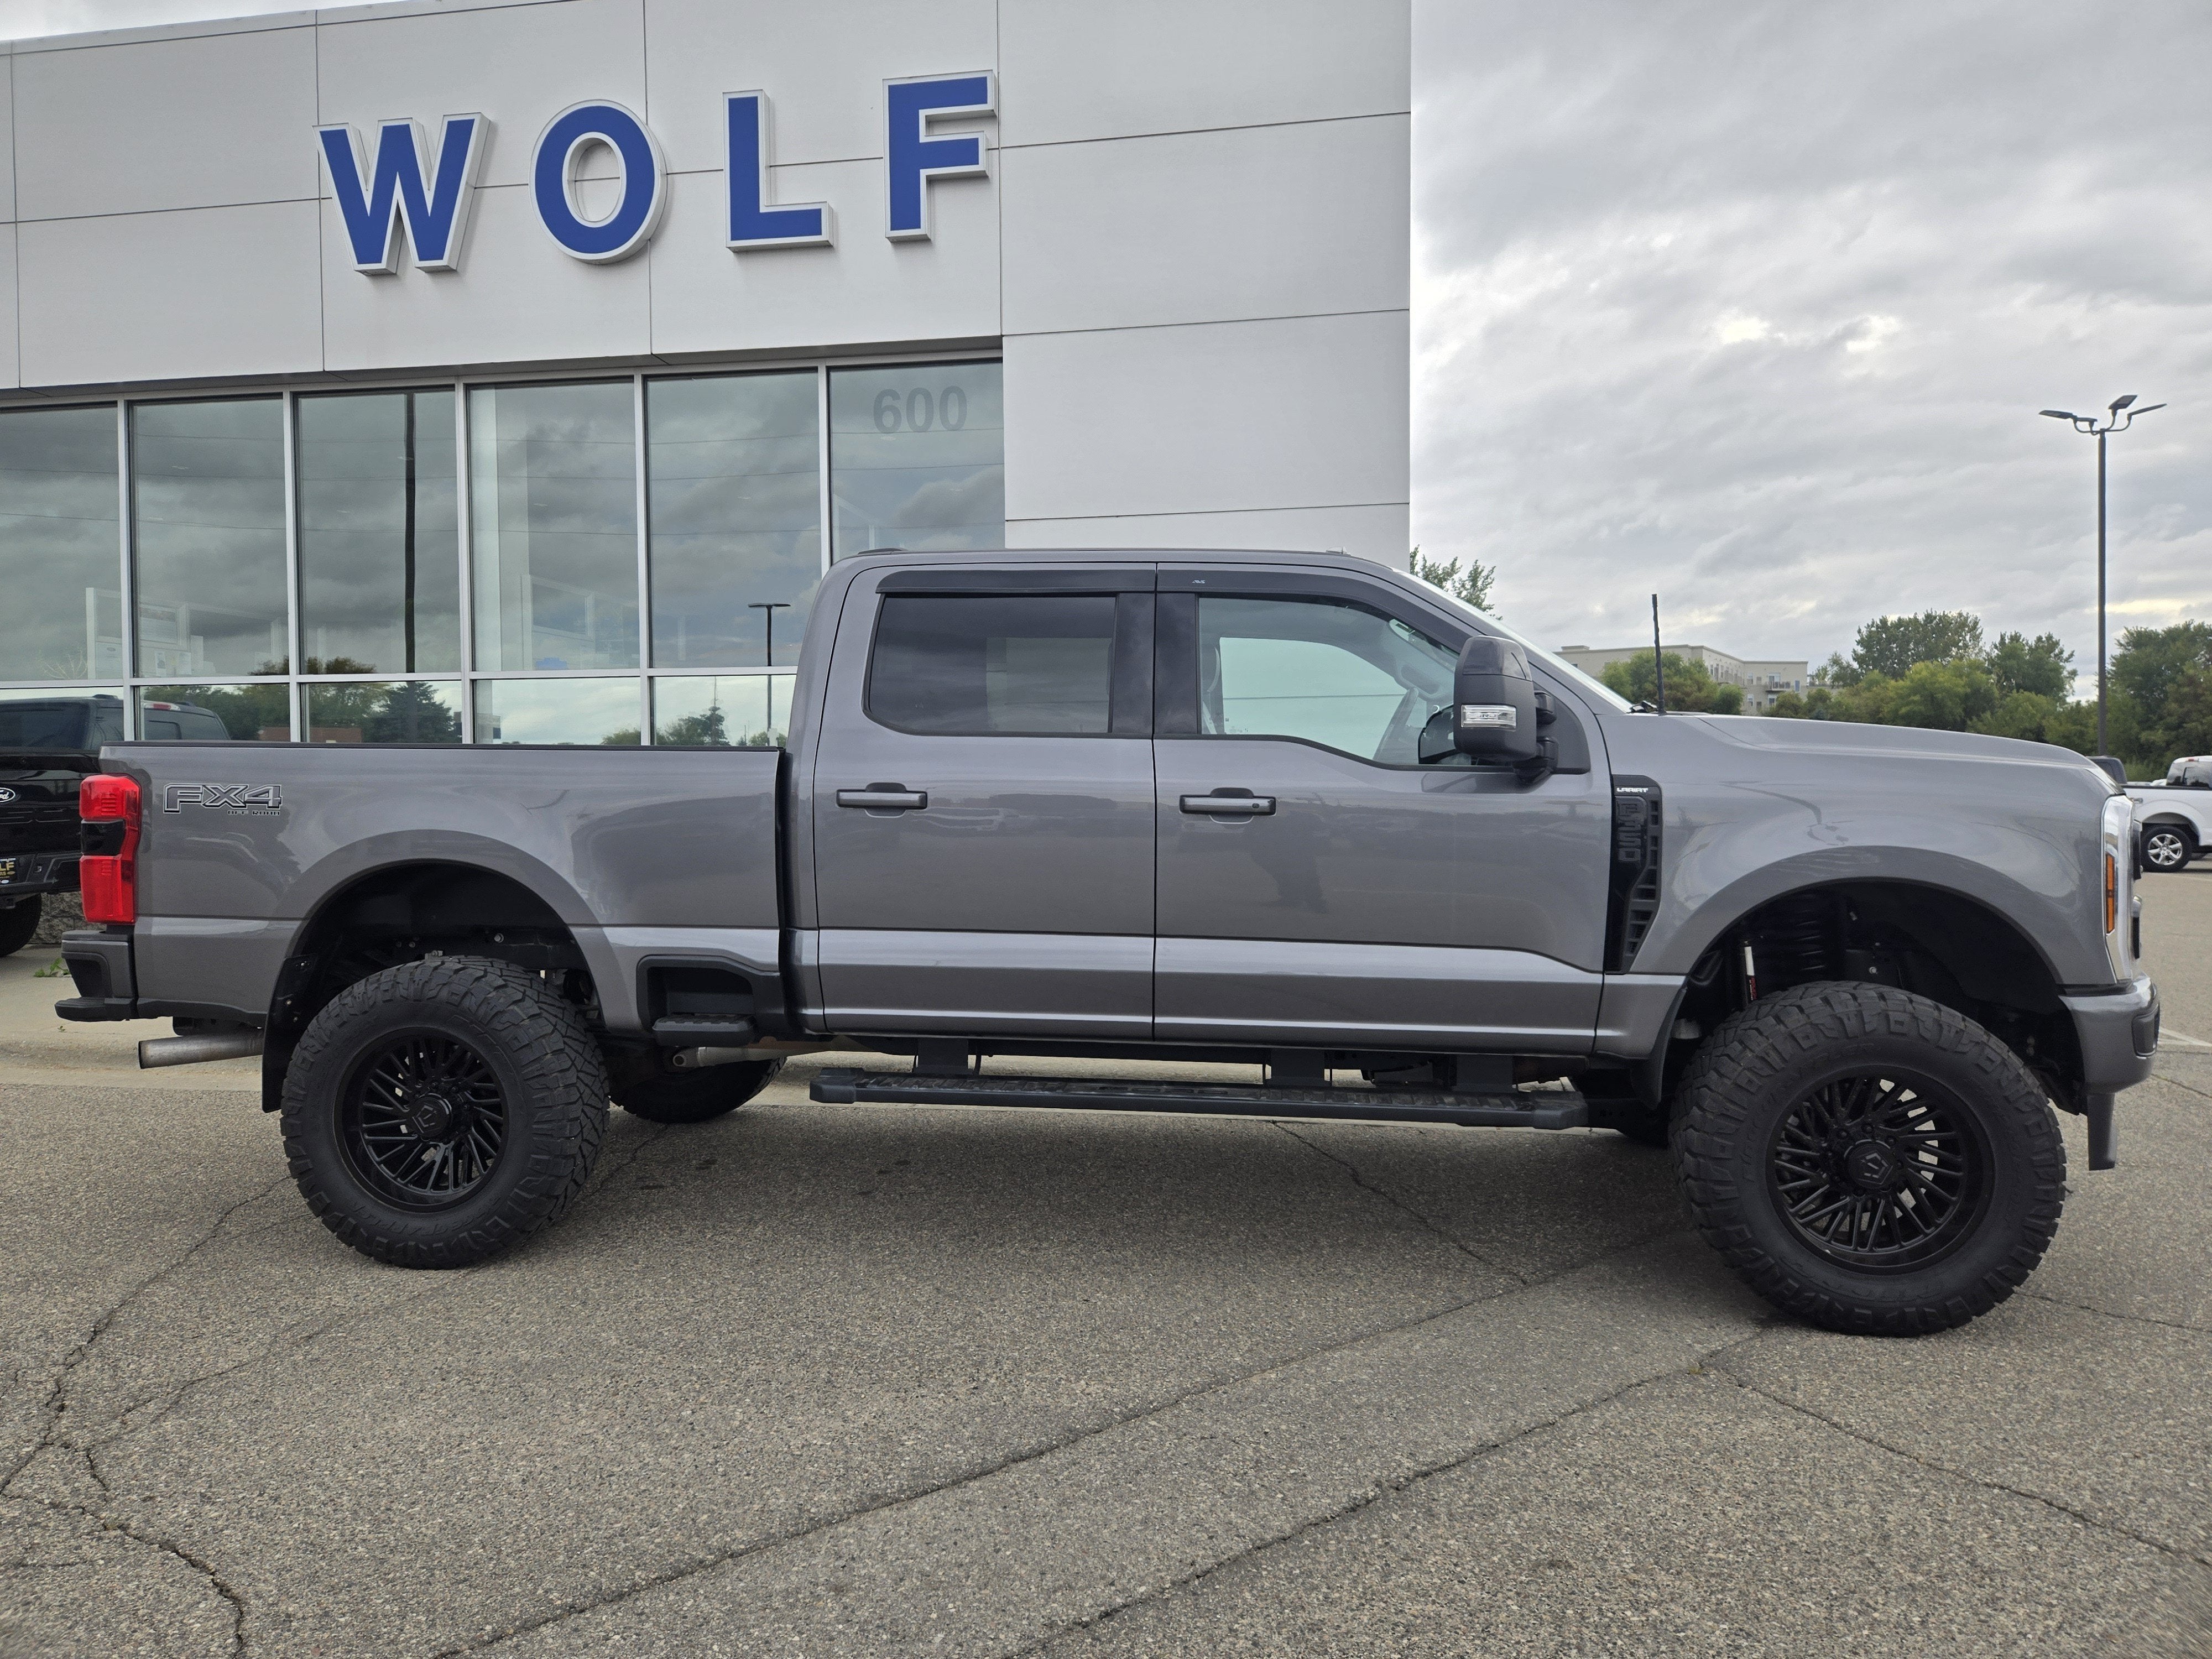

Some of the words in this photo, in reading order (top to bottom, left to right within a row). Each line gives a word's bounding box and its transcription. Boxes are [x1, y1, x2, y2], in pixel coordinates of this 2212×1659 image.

[312, 70, 997, 275] WOLF
[873, 385, 967, 434] 600
[163, 782, 283, 814] FX4
